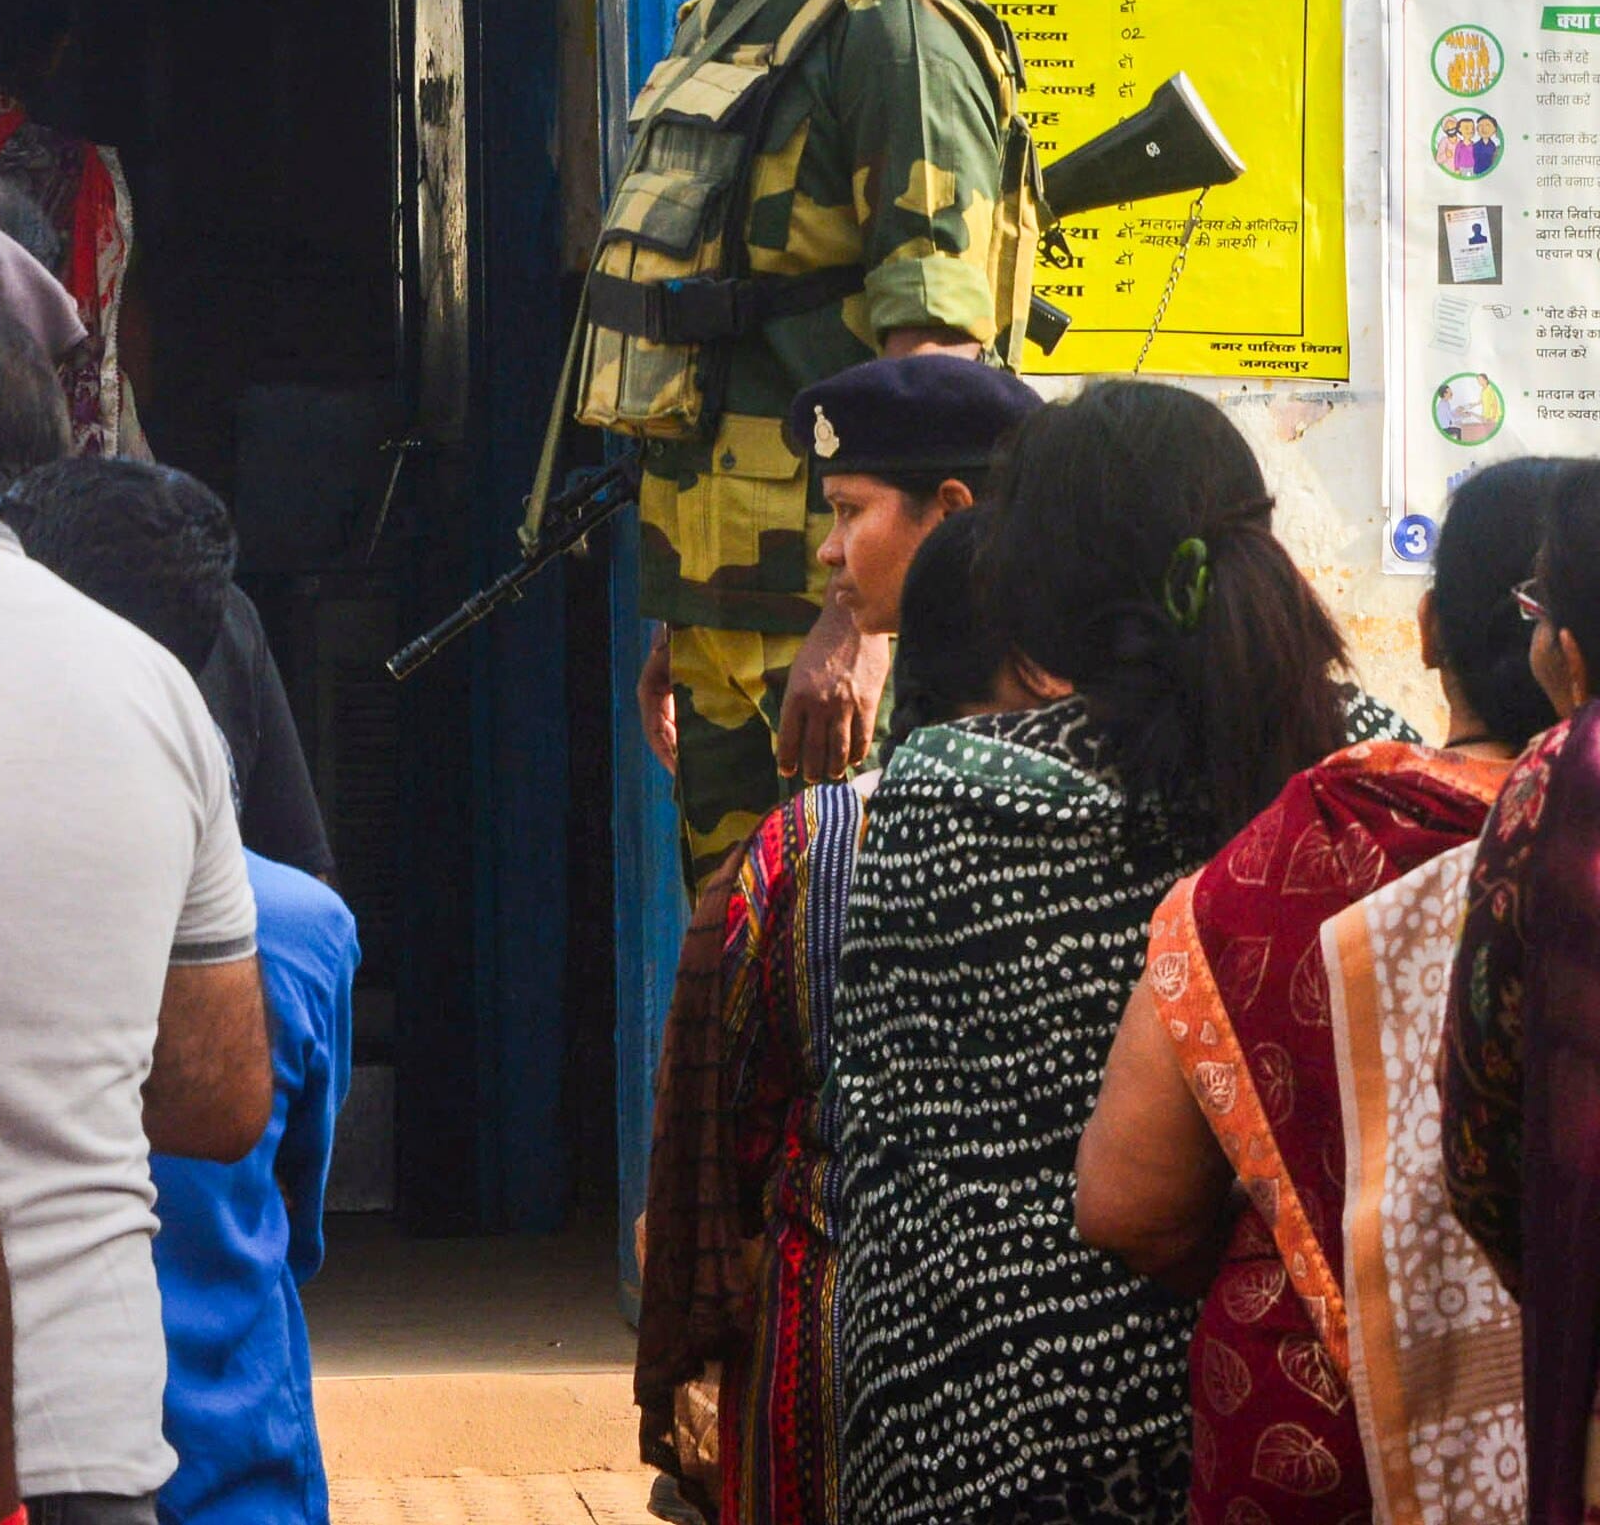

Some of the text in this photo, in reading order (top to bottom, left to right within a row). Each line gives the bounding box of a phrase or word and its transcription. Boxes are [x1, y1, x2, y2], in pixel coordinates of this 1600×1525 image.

[1556, 12, 1591, 29] क्या
[1559, 70, 1590, 85] अपनी
[1536, 132, 1575, 145] मतदान
[1536, 155, 1558, 167] तथा
[1535, 208, 1564, 220] भारत
[1535, 228, 1560, 240] द्वारा
[1535, 248, 1573, 261] पहचान
[1567, 306, 1588, 320] कैसे
[1536, 325, 1548, 339] के
[1586, 328, 1600, 339] का
[1210, 340, 1343, 355] नगर पालिक निगम
[1536, 347, 1567, 359] पालन
[1239, 359, 1309, 373] जगदलपुर
[1536, 389, 1575, 401] मतदान
[1578, 389, 1595, 401] दल
[1403, 523, 1428, 552] 3
